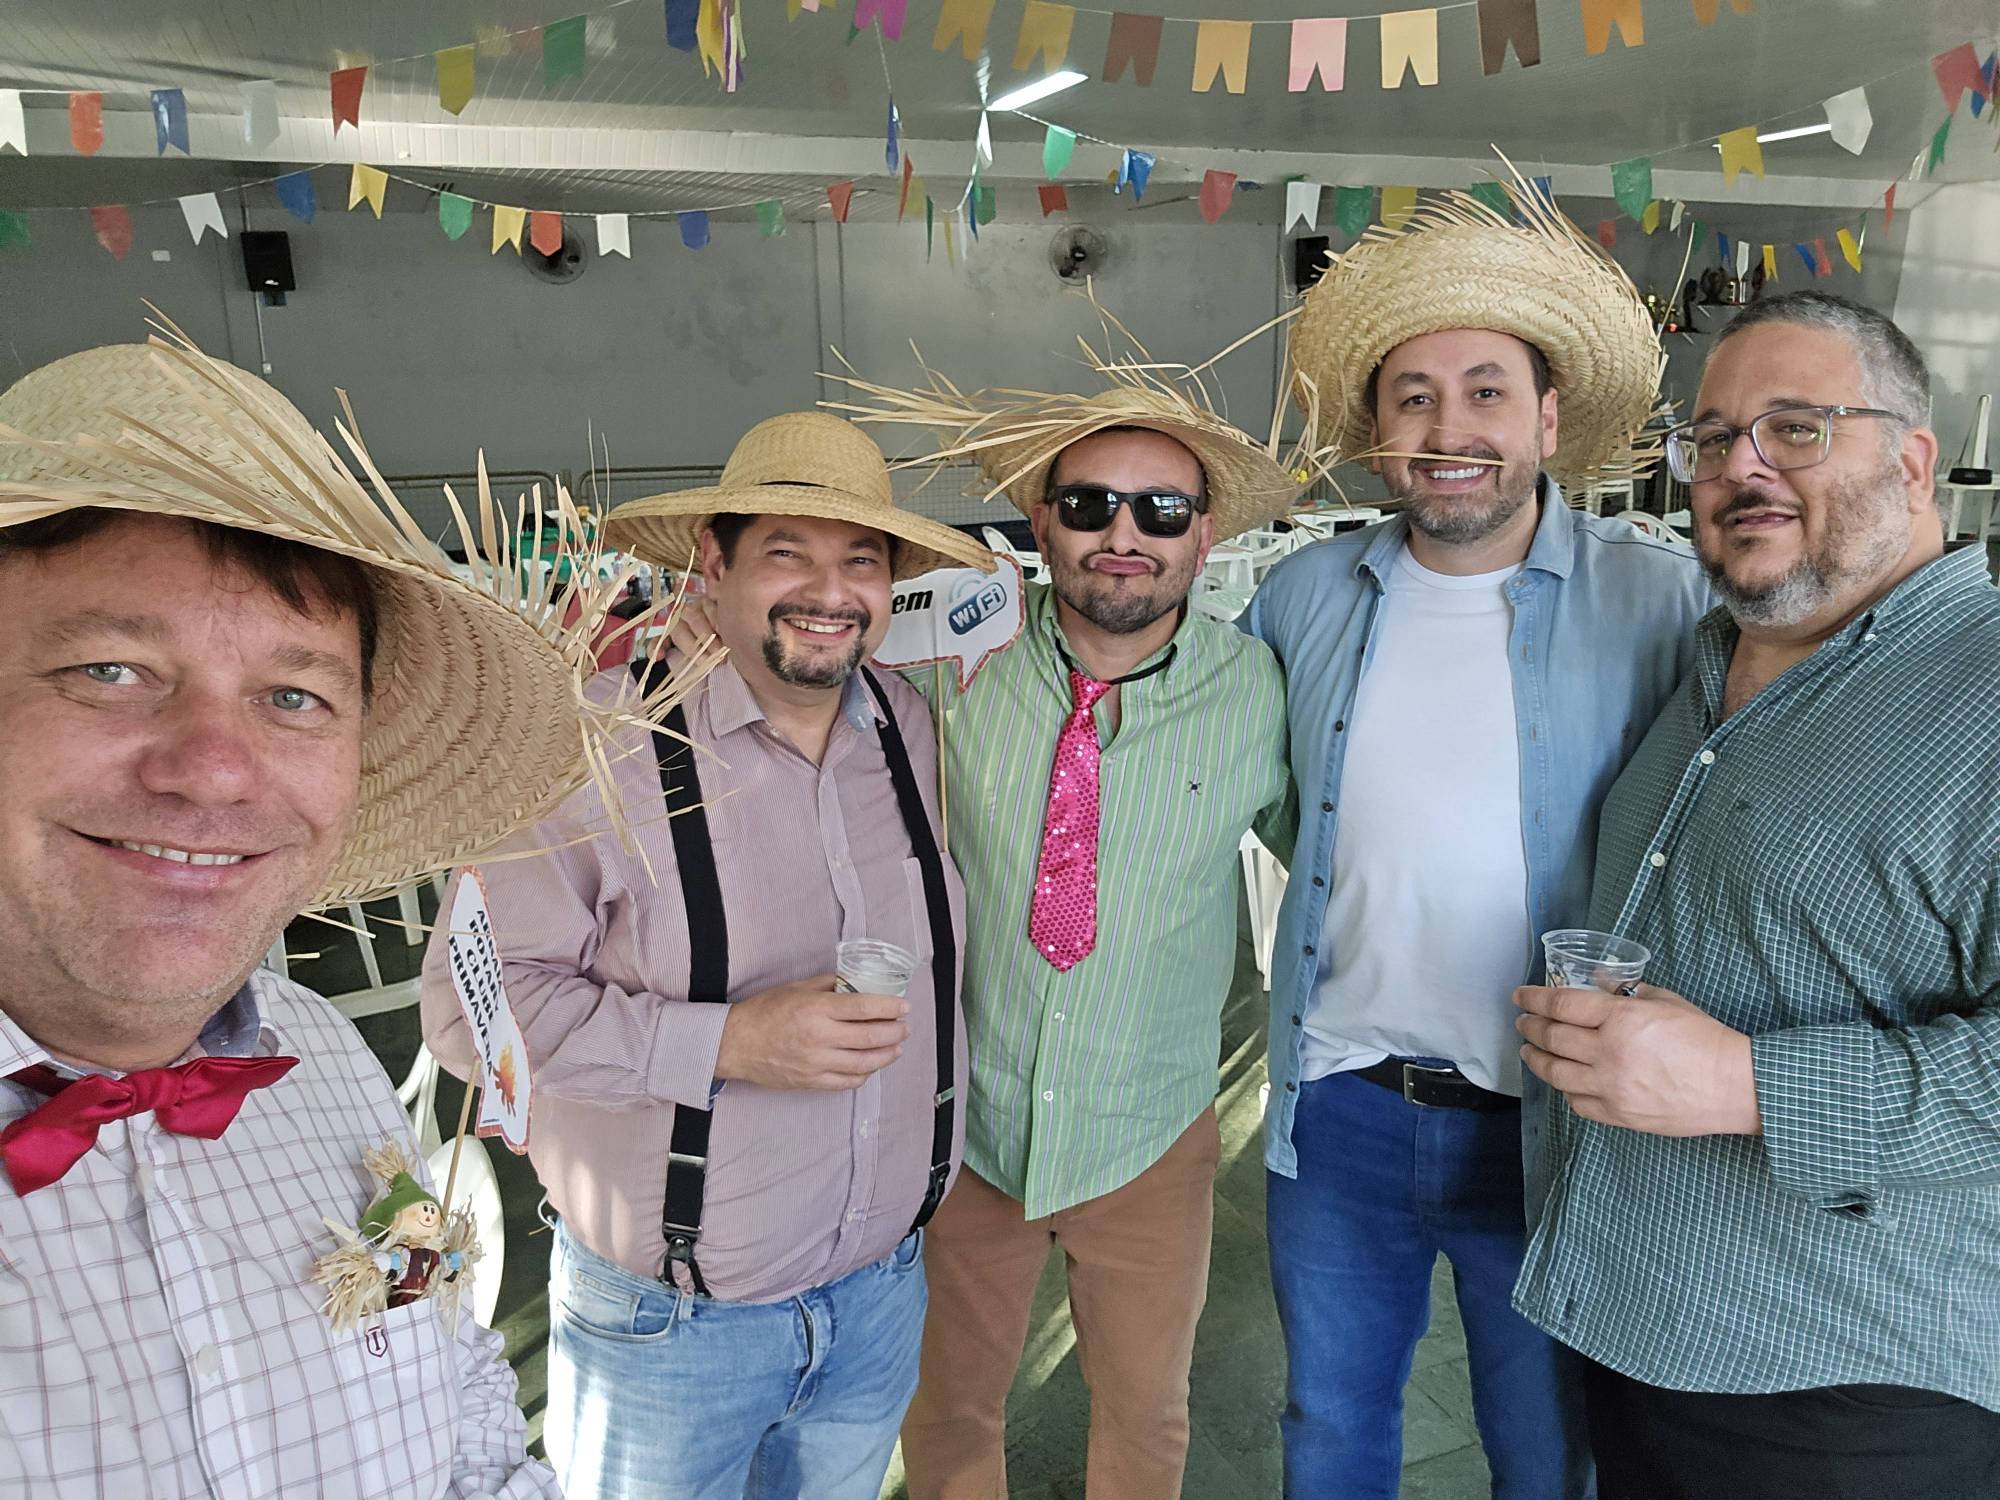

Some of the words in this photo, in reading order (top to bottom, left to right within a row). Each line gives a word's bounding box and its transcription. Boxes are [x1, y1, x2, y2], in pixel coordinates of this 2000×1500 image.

[892, 590, 933, 614] em
[449, 935, 492, 1076] PRIMAVERA
[469, 919, 499, 1012] ROTARY
